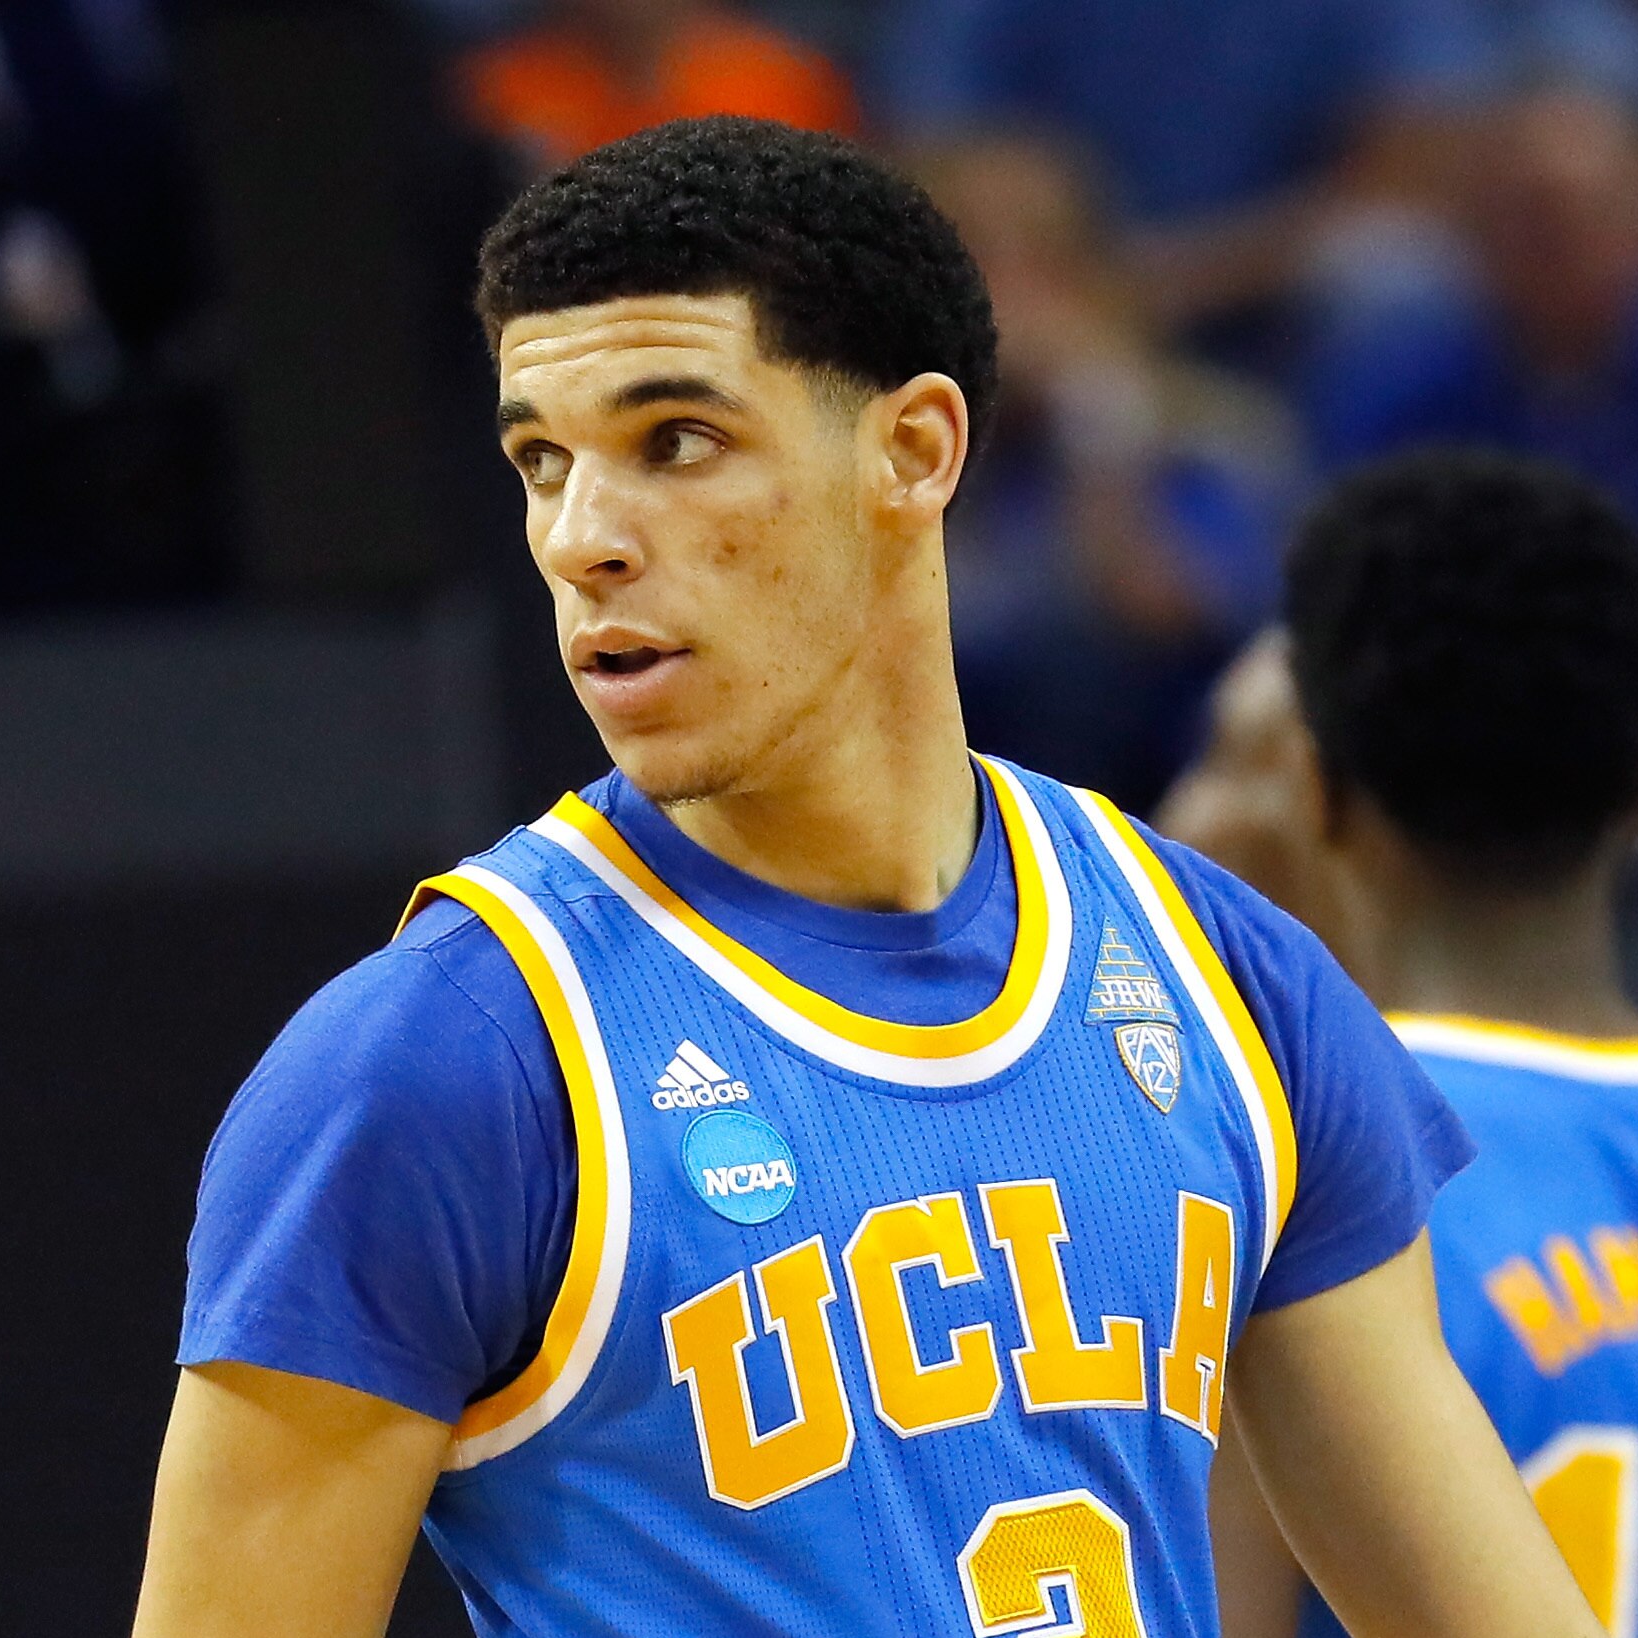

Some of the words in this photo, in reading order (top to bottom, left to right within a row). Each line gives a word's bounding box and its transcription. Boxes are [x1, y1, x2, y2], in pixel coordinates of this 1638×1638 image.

[1142, 1061, 1173, 1093] 12
[651, 1080, 750, 1110] adidas
[702, 1159, 794, 1196] NCAA
[662, 1178, 1234, 1509] UCLA
